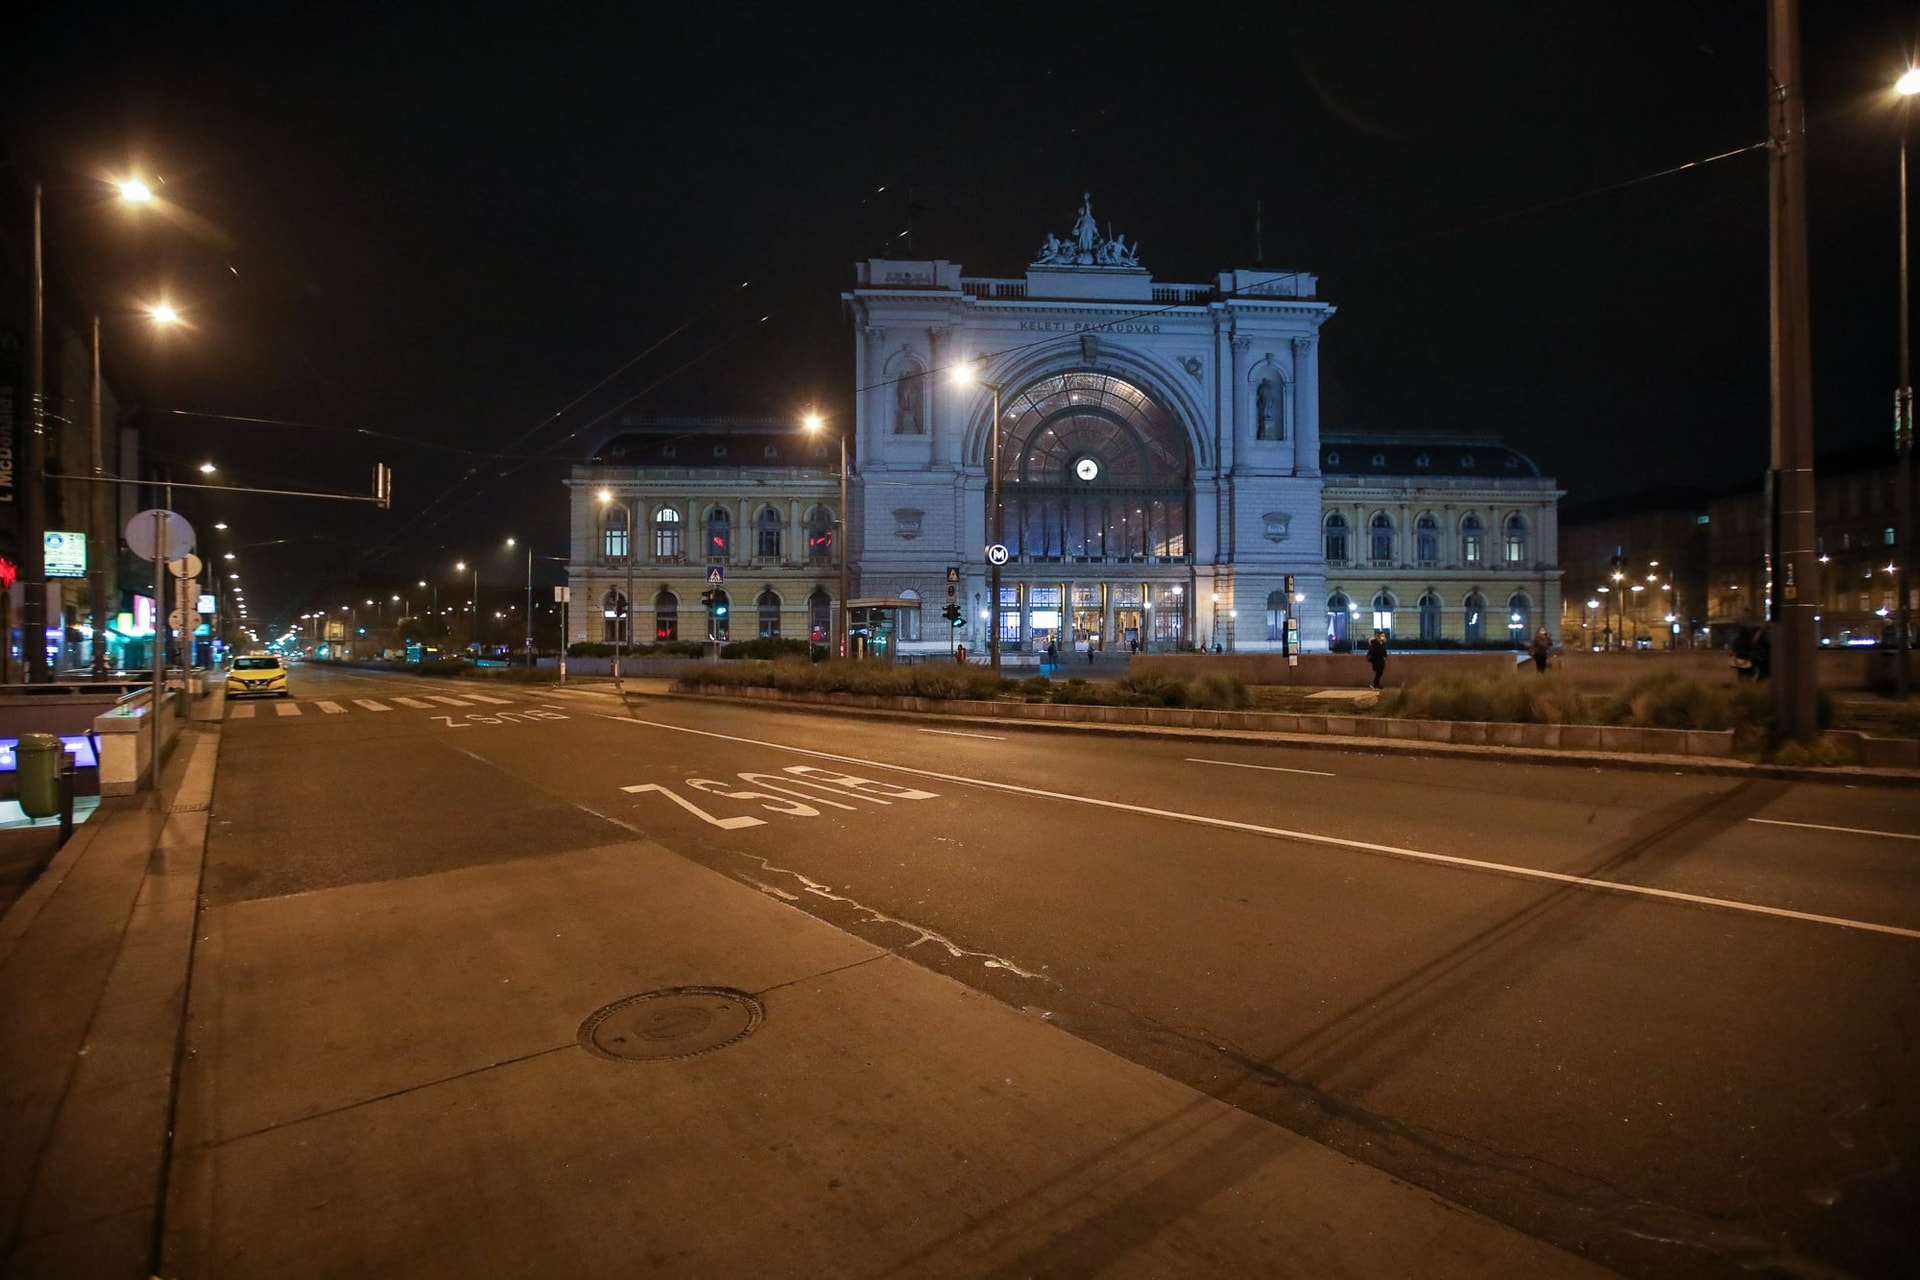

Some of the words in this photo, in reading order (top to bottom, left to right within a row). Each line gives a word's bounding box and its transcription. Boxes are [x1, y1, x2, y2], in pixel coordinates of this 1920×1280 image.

[1020, 321, 1065, 331] KELETI
[430, 710, 572, 727] BUSZ
[619, 765, 942, 830] BUSZ
